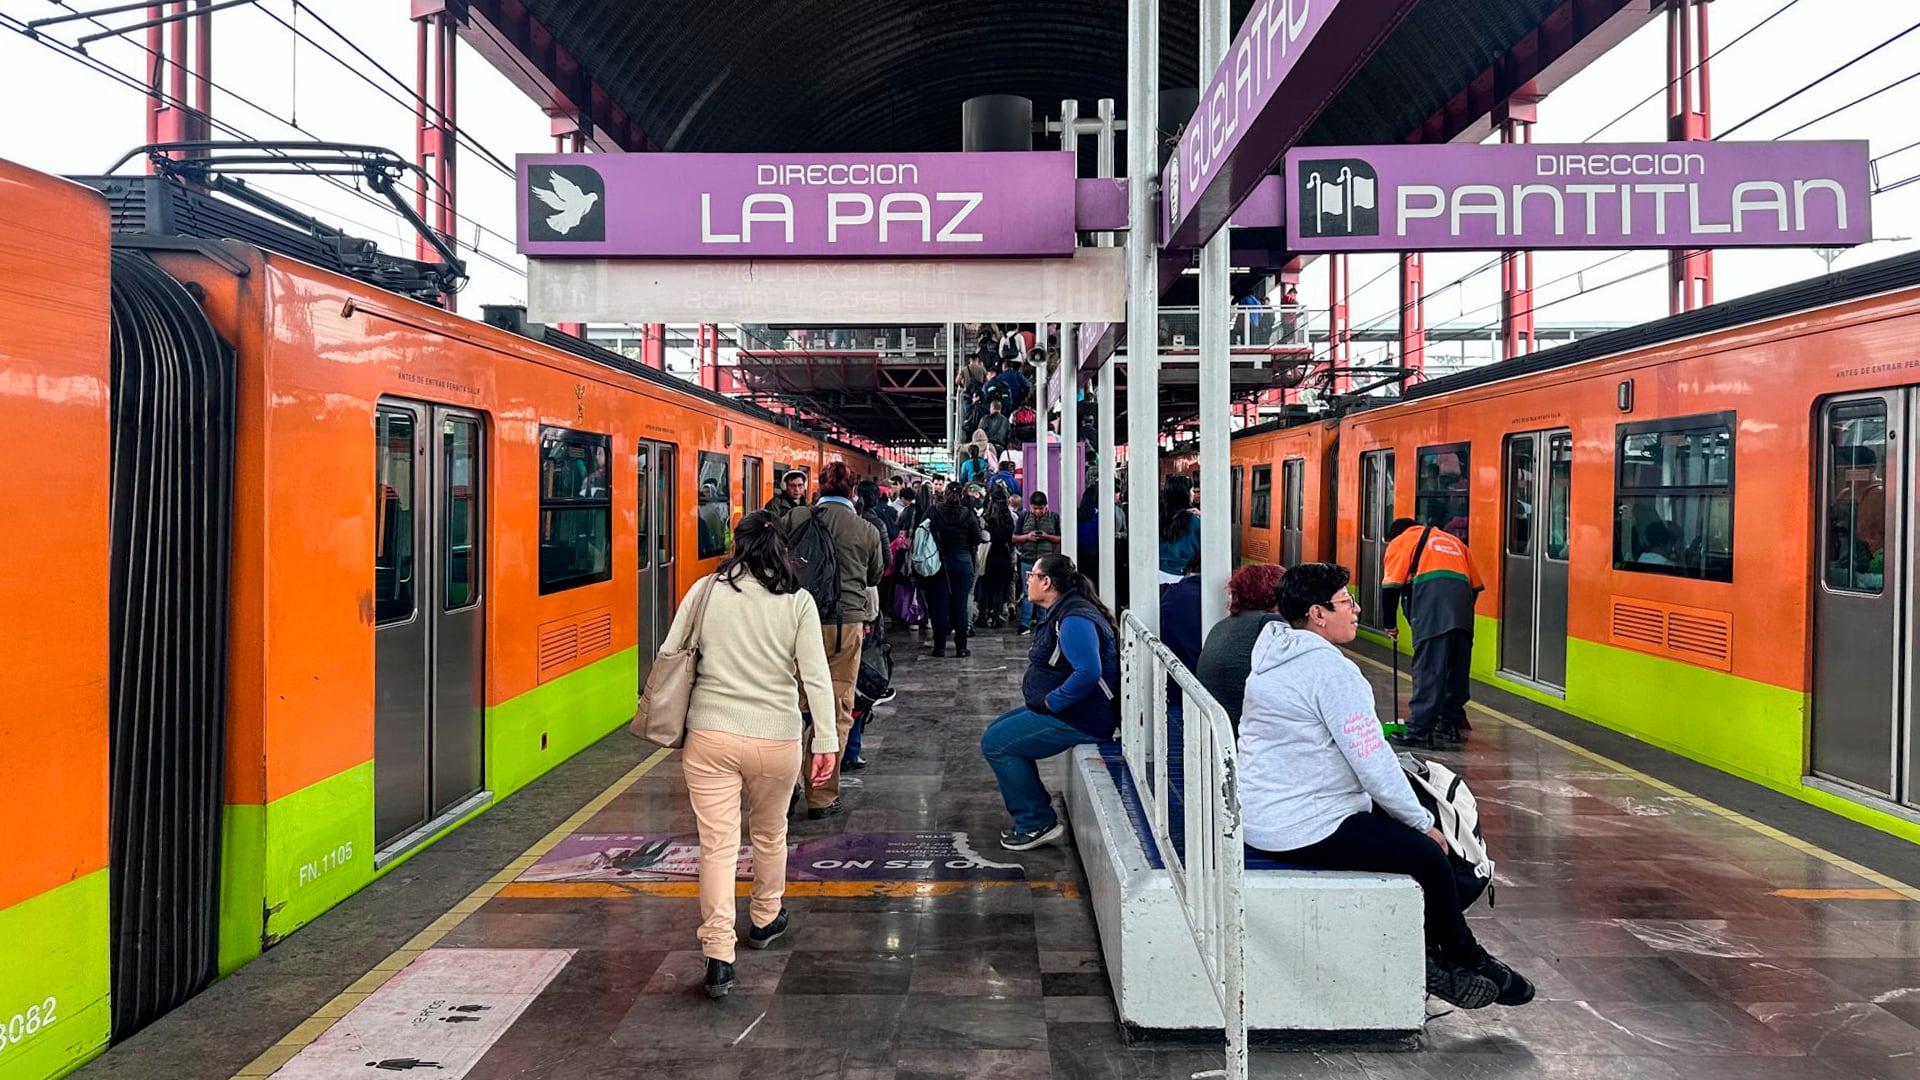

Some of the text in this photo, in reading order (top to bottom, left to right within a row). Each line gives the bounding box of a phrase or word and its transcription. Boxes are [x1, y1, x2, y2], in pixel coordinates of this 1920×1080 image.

[757, 164, 918, 185] DIRECCION
[1536, 153, 1705, 177] DIRECCION
[701, 192, 985, 243] LA PAZ
[1397, 179, 1848, 236] PANTITLAN
[1836, 369, 1858, 378] ANTES
[1860, 367, 1871, 375] DE
[1871, 362, 1902, 373] ENTRAR
[398, 372, 415, 383] ANTES
[416, 376, 425, 384] DE
[425, 378, 446, 388] ENTRAR
[446, 382, 466, 393] PERMITA
[299, 841, 353, 887] FN.1105
[812, 860, 874, 869] NO
[883, 860, 933, 869] ES
